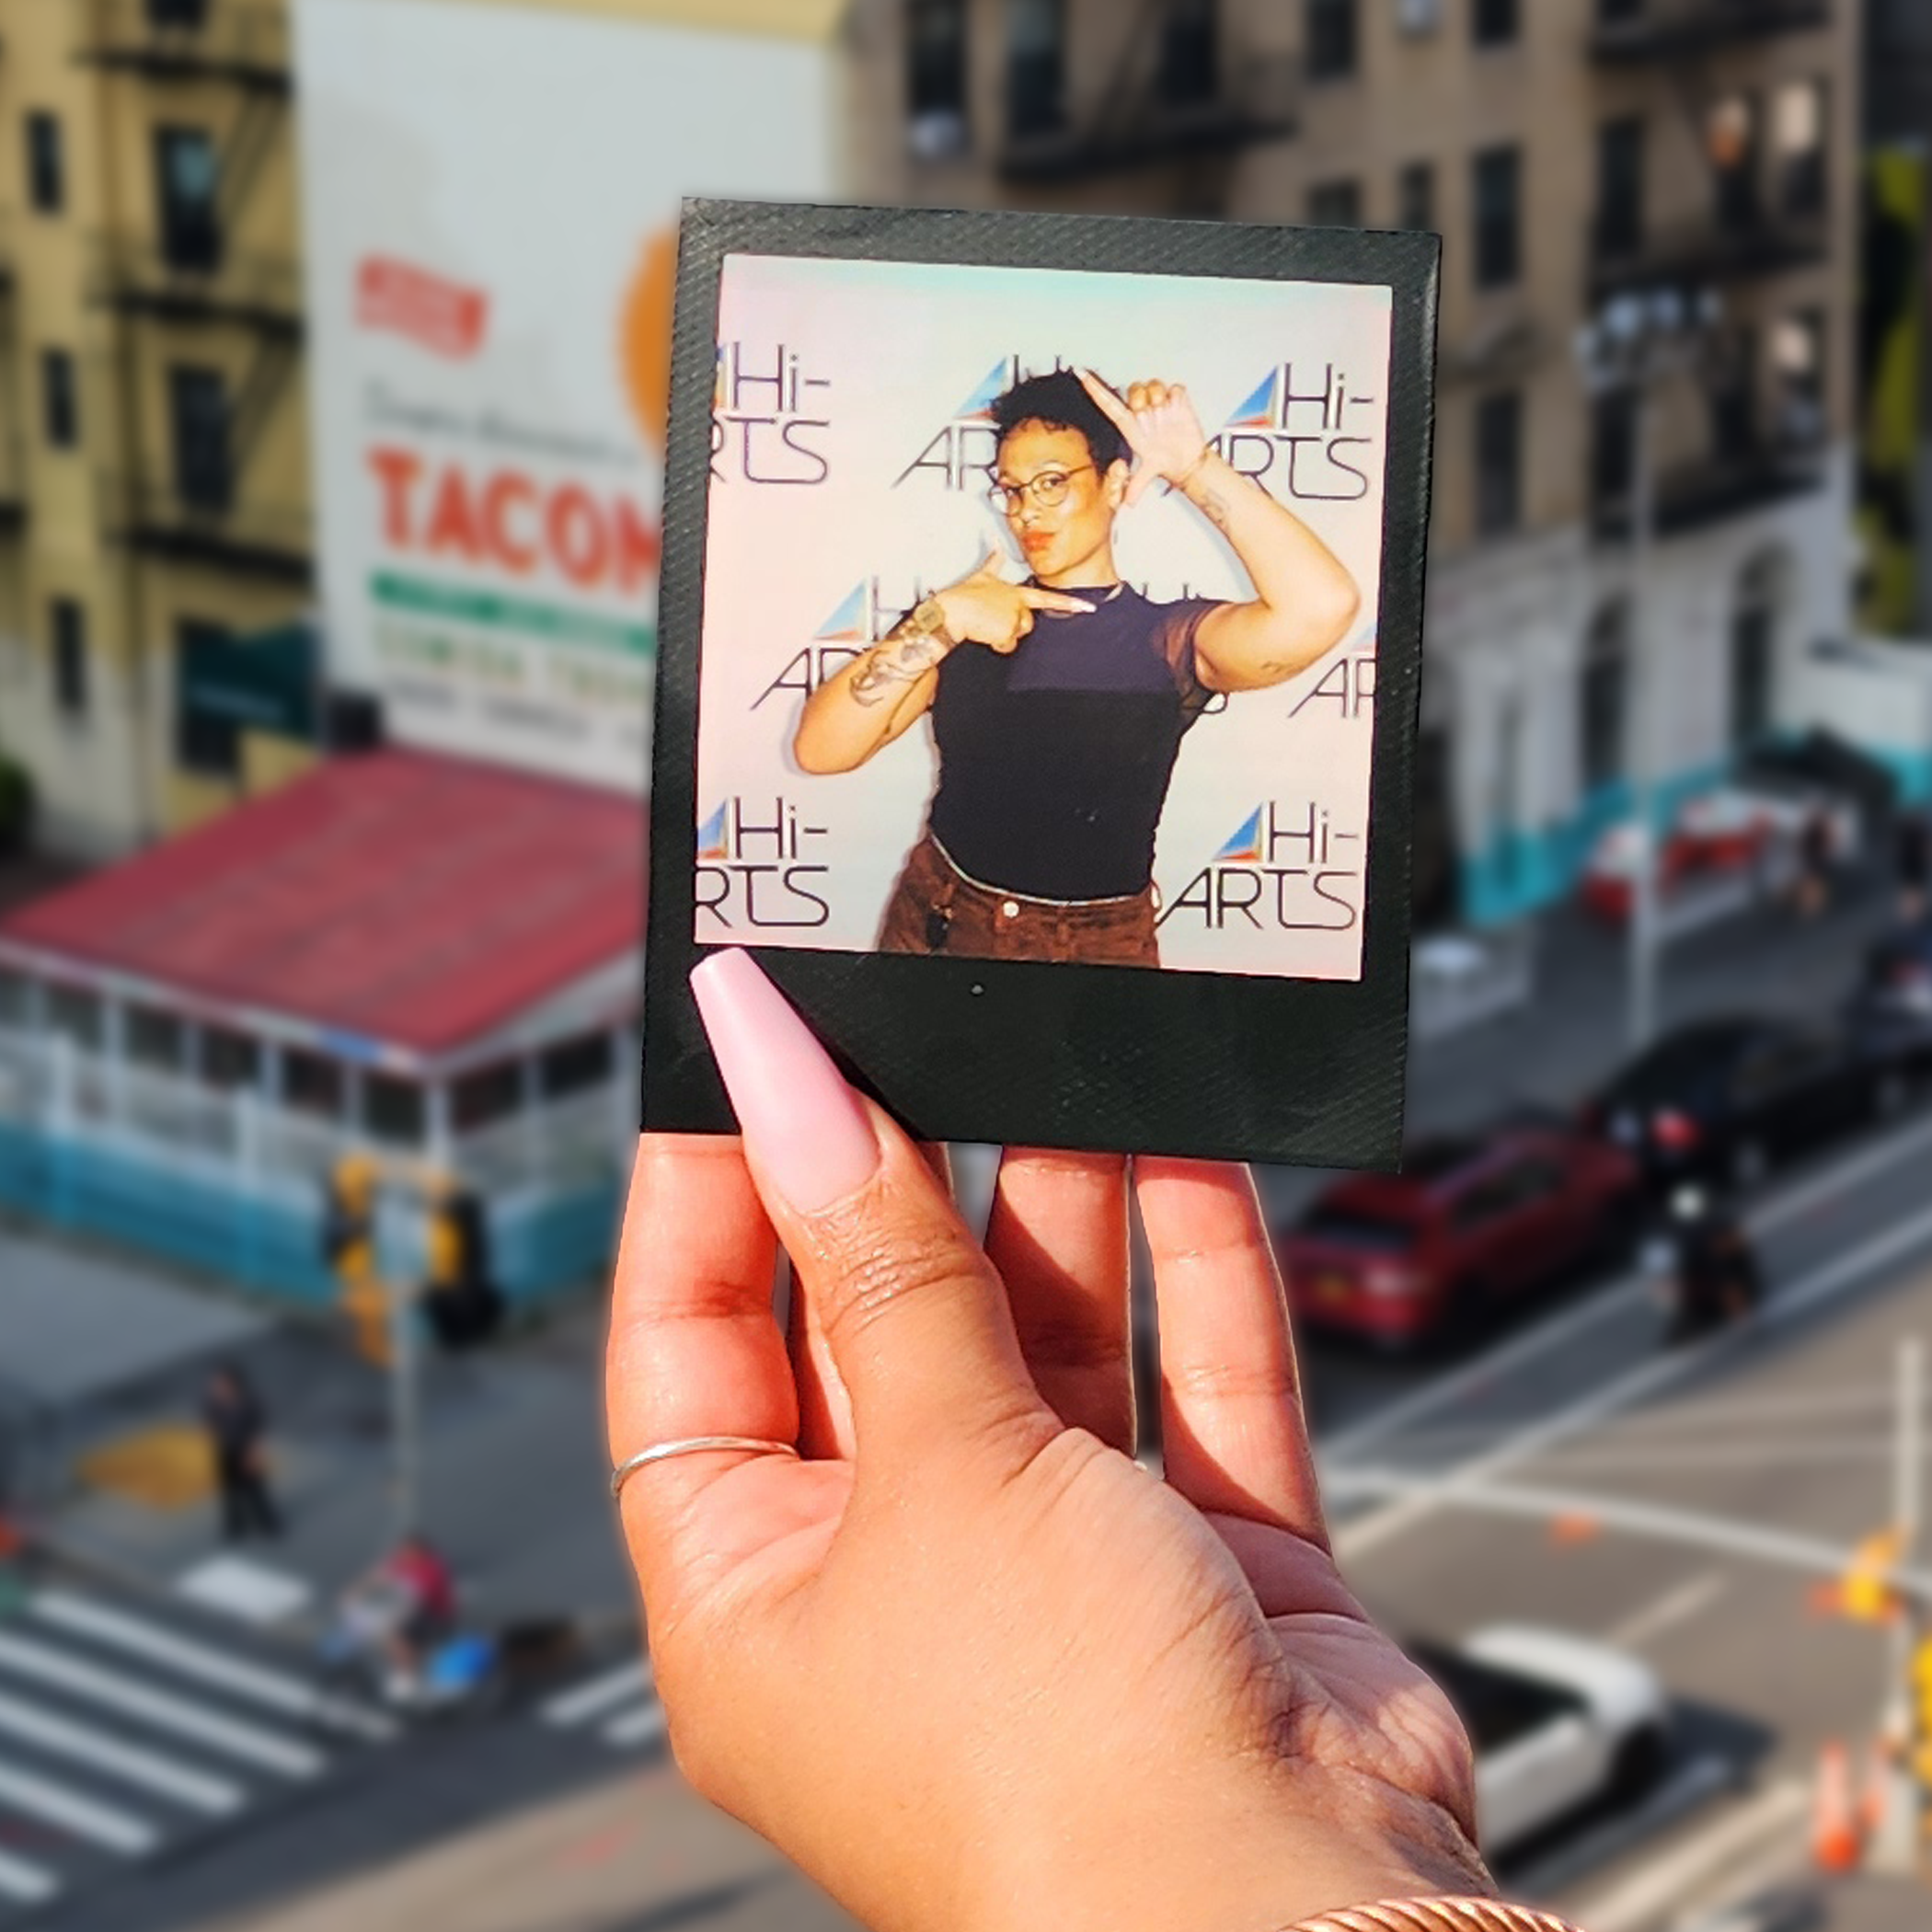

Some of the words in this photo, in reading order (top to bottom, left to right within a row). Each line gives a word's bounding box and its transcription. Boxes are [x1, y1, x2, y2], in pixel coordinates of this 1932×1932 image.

[732, 341, 832, 413] Hi-
[1282, 362, 1374, 431] Hi-
[734, 796, 829, 859] Hi-
[1268, 799, 1360, 864] Hi-
[1156, 867, 1357, 931] ARTS
